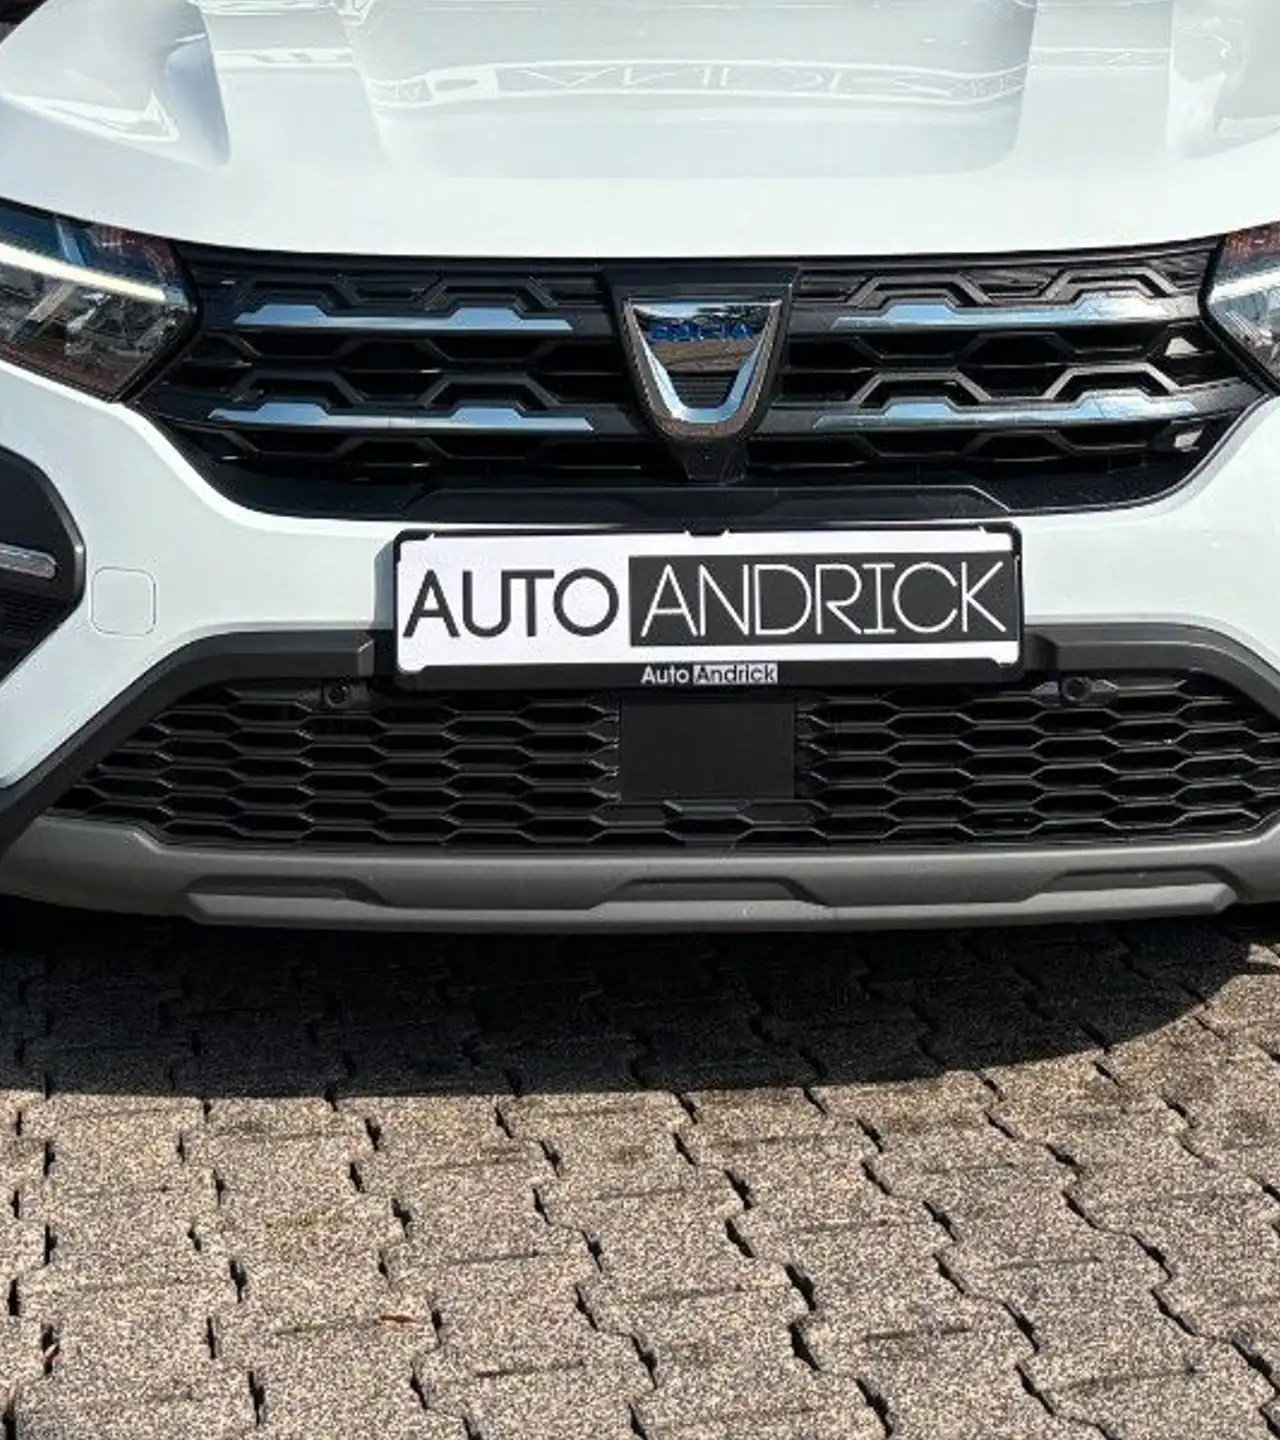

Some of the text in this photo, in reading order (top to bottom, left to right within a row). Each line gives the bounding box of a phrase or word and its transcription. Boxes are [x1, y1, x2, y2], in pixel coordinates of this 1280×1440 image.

[401, 559, 1008, 639] AUTO ANDRICK
[639, 663, 777, 685] Auto Andrick
